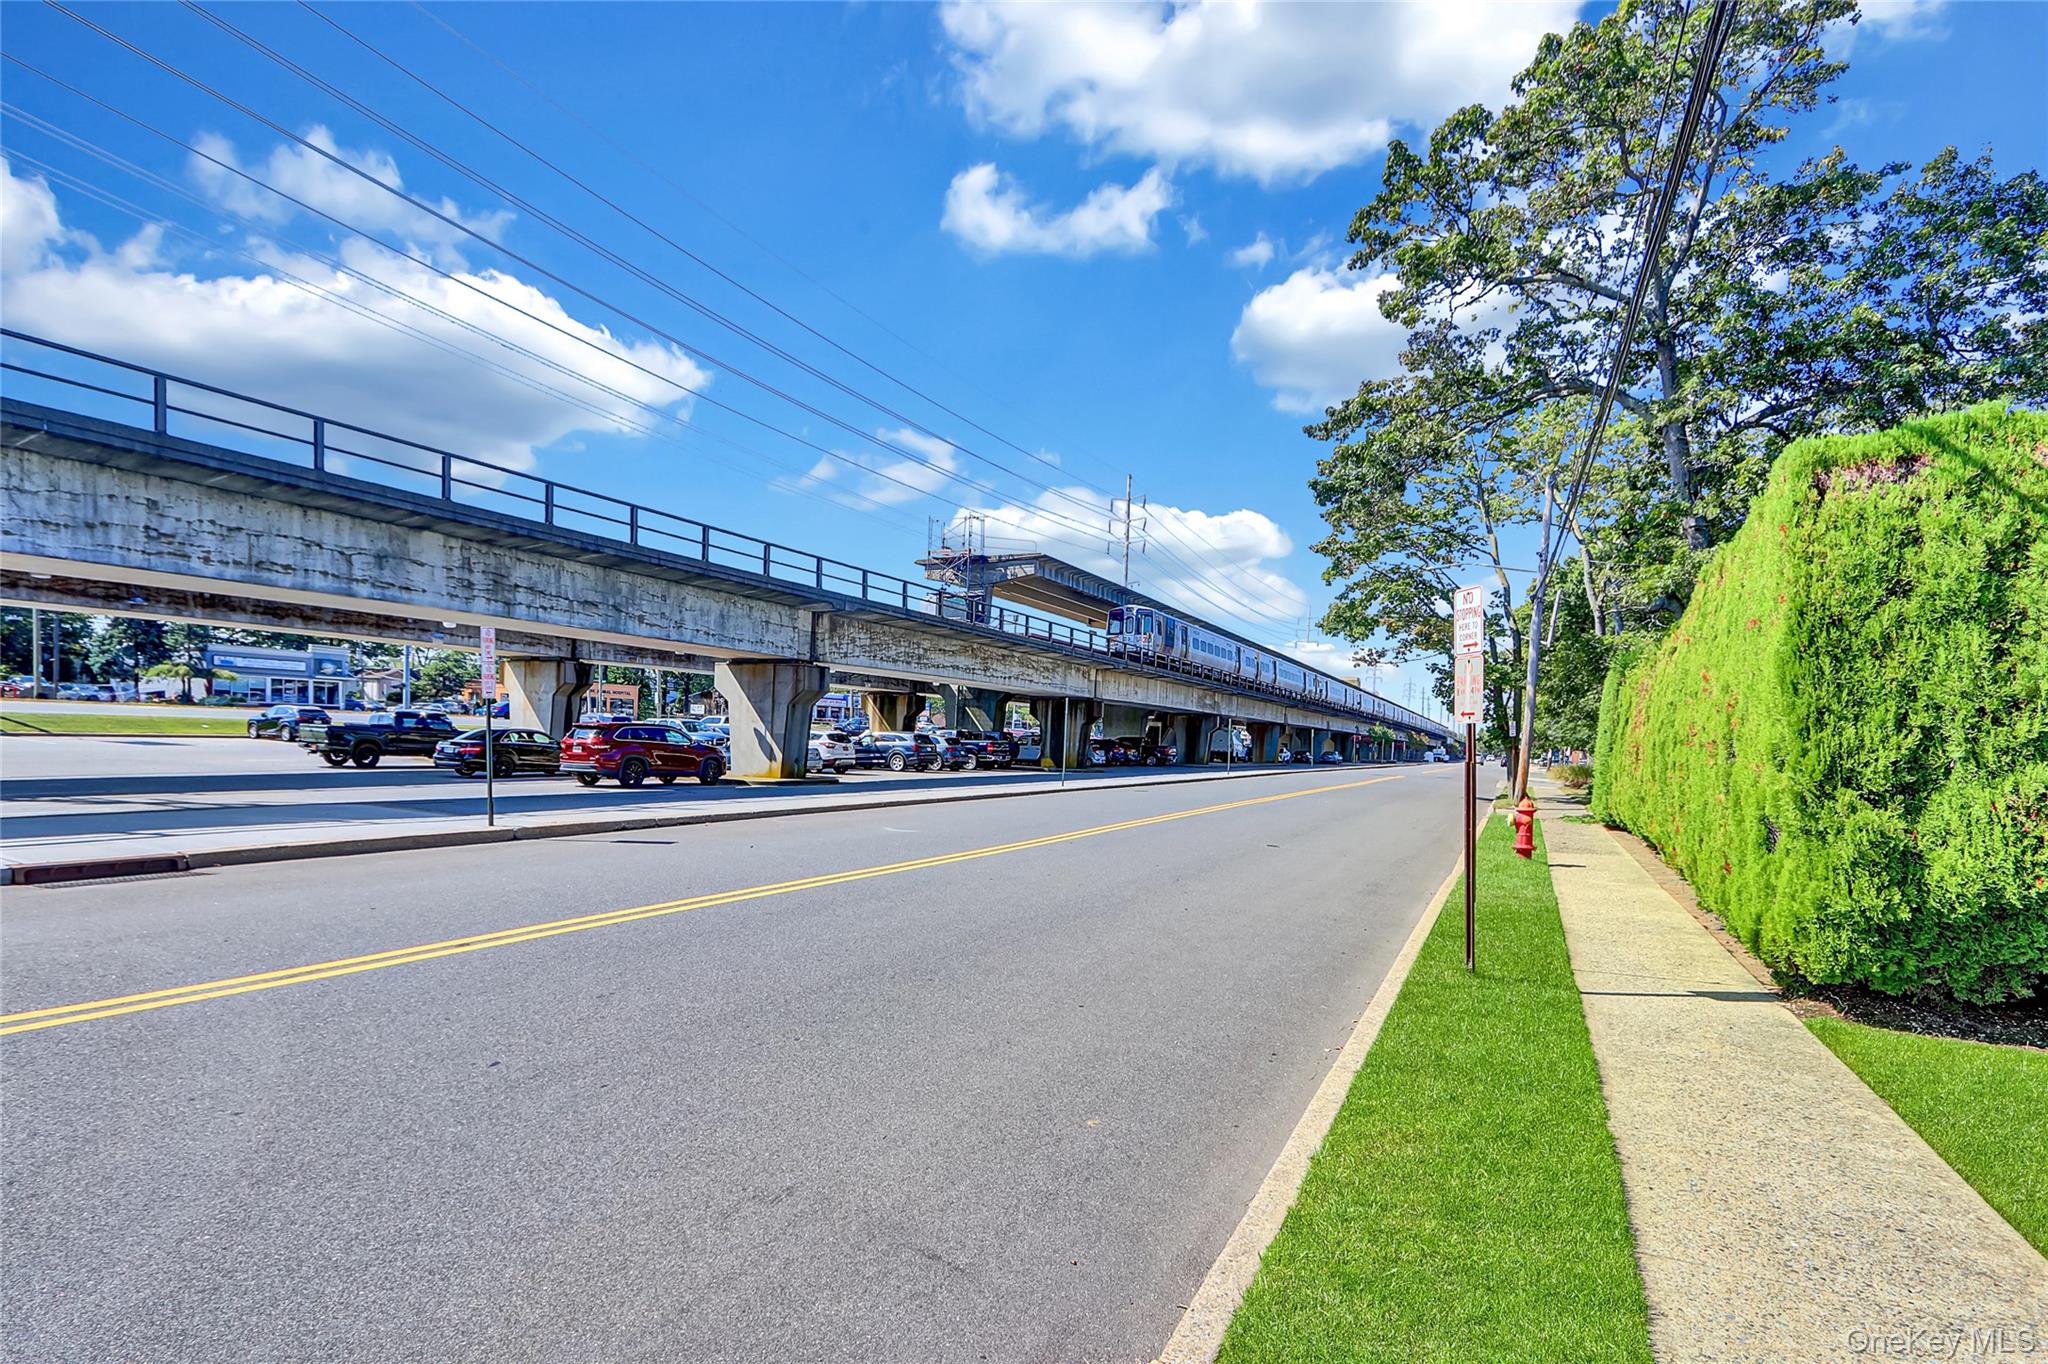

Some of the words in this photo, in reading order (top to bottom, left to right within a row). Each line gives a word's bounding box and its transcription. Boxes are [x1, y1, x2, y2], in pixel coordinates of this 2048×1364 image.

[1462, 592, 1474, 605] NO
[1456, 605, 1481, 621] STOPPING
[1459, 622, 1471, 631] HERE
[1472, 620, 1479, 630] TO
[1459, 631, 1478, 641] CORNER
